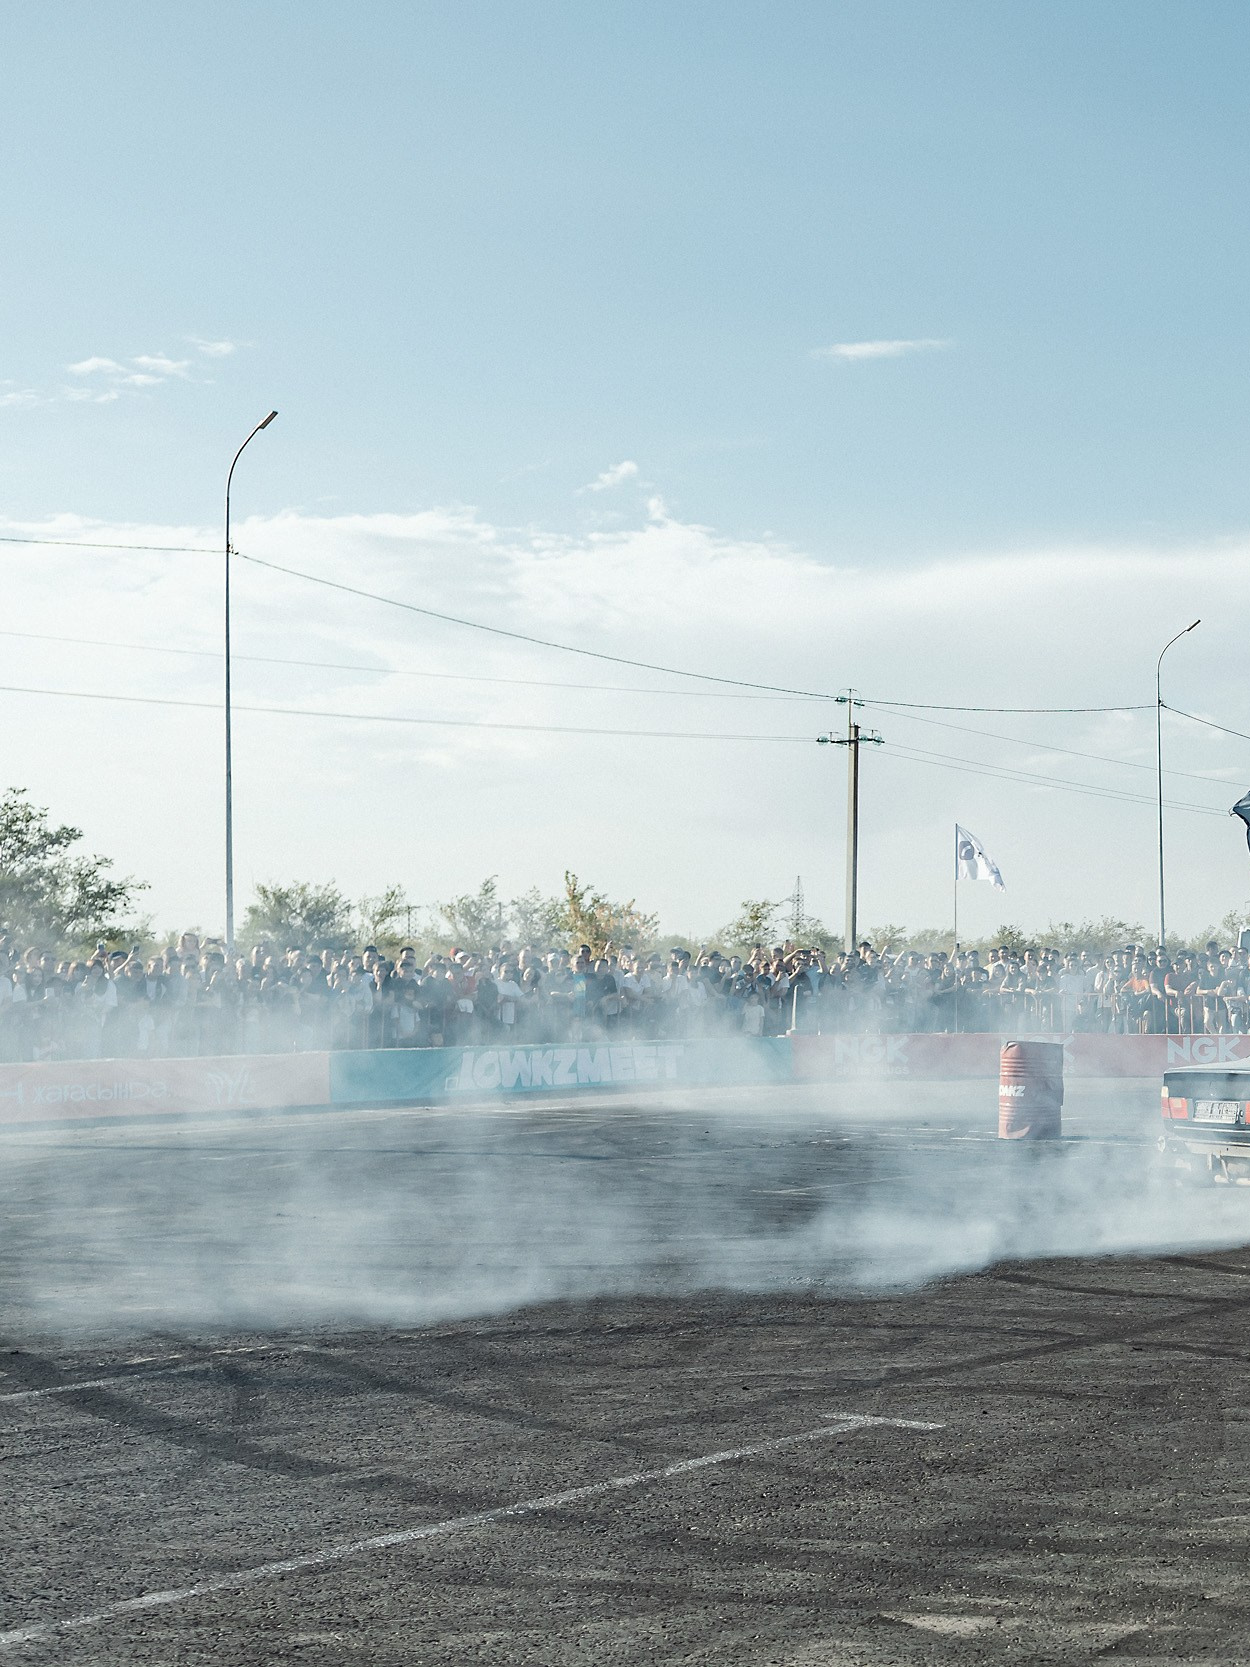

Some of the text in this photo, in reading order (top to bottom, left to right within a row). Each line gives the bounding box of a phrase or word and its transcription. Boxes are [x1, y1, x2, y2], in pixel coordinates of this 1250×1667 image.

[834, 1035, 910, 1065] NGK
[1167, 1036, 1242, 1064] NGK
[457, 1045, 685, 1091] LOWKZMEET
